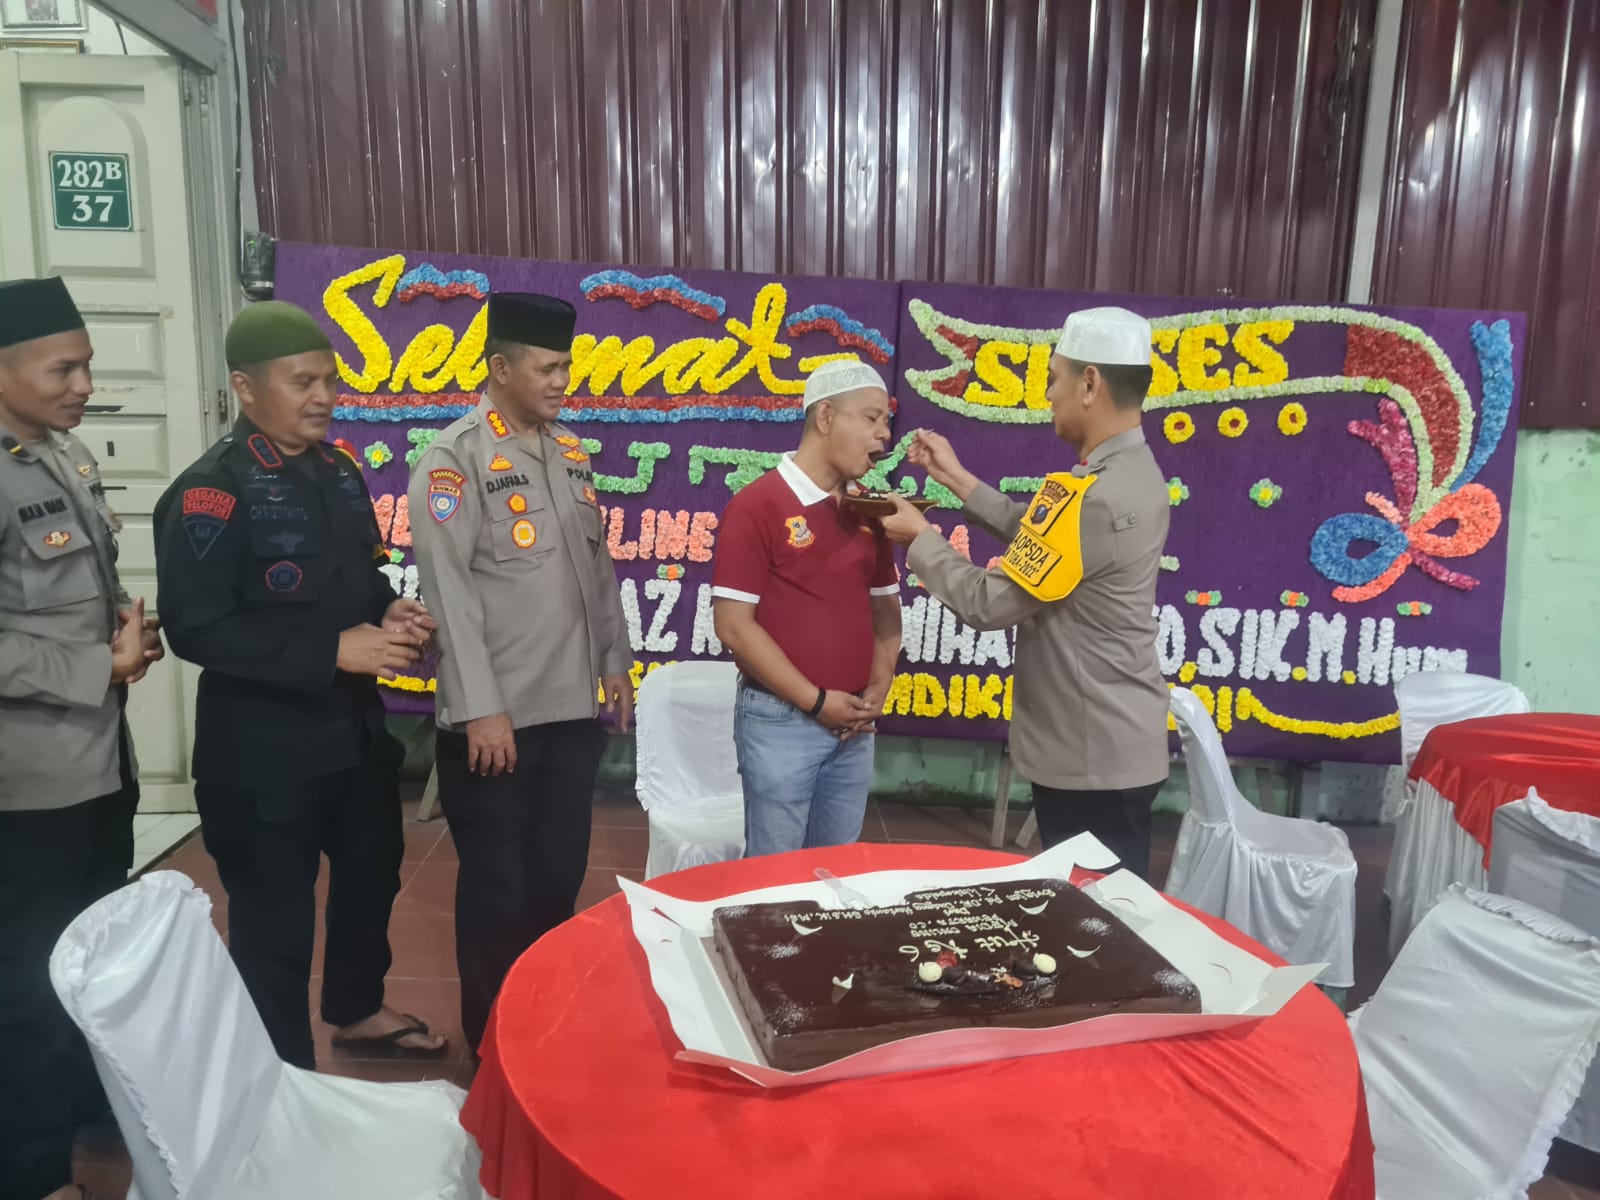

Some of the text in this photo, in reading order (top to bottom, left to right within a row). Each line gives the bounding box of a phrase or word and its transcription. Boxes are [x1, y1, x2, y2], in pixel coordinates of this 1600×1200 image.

[57, 160, 123, 189] 282B
[71, 194, 115, 223] 37
[323, 253, 807, 396] Selmat
[963, 319, 1295, 410] SSES
[187, 489, 233, 505] GEGANA
[1046, 480, 1067, 498] POLDA
[599, 505, 719, 562] LINE
[1013, 532, 1051, 568] AOPSDA
